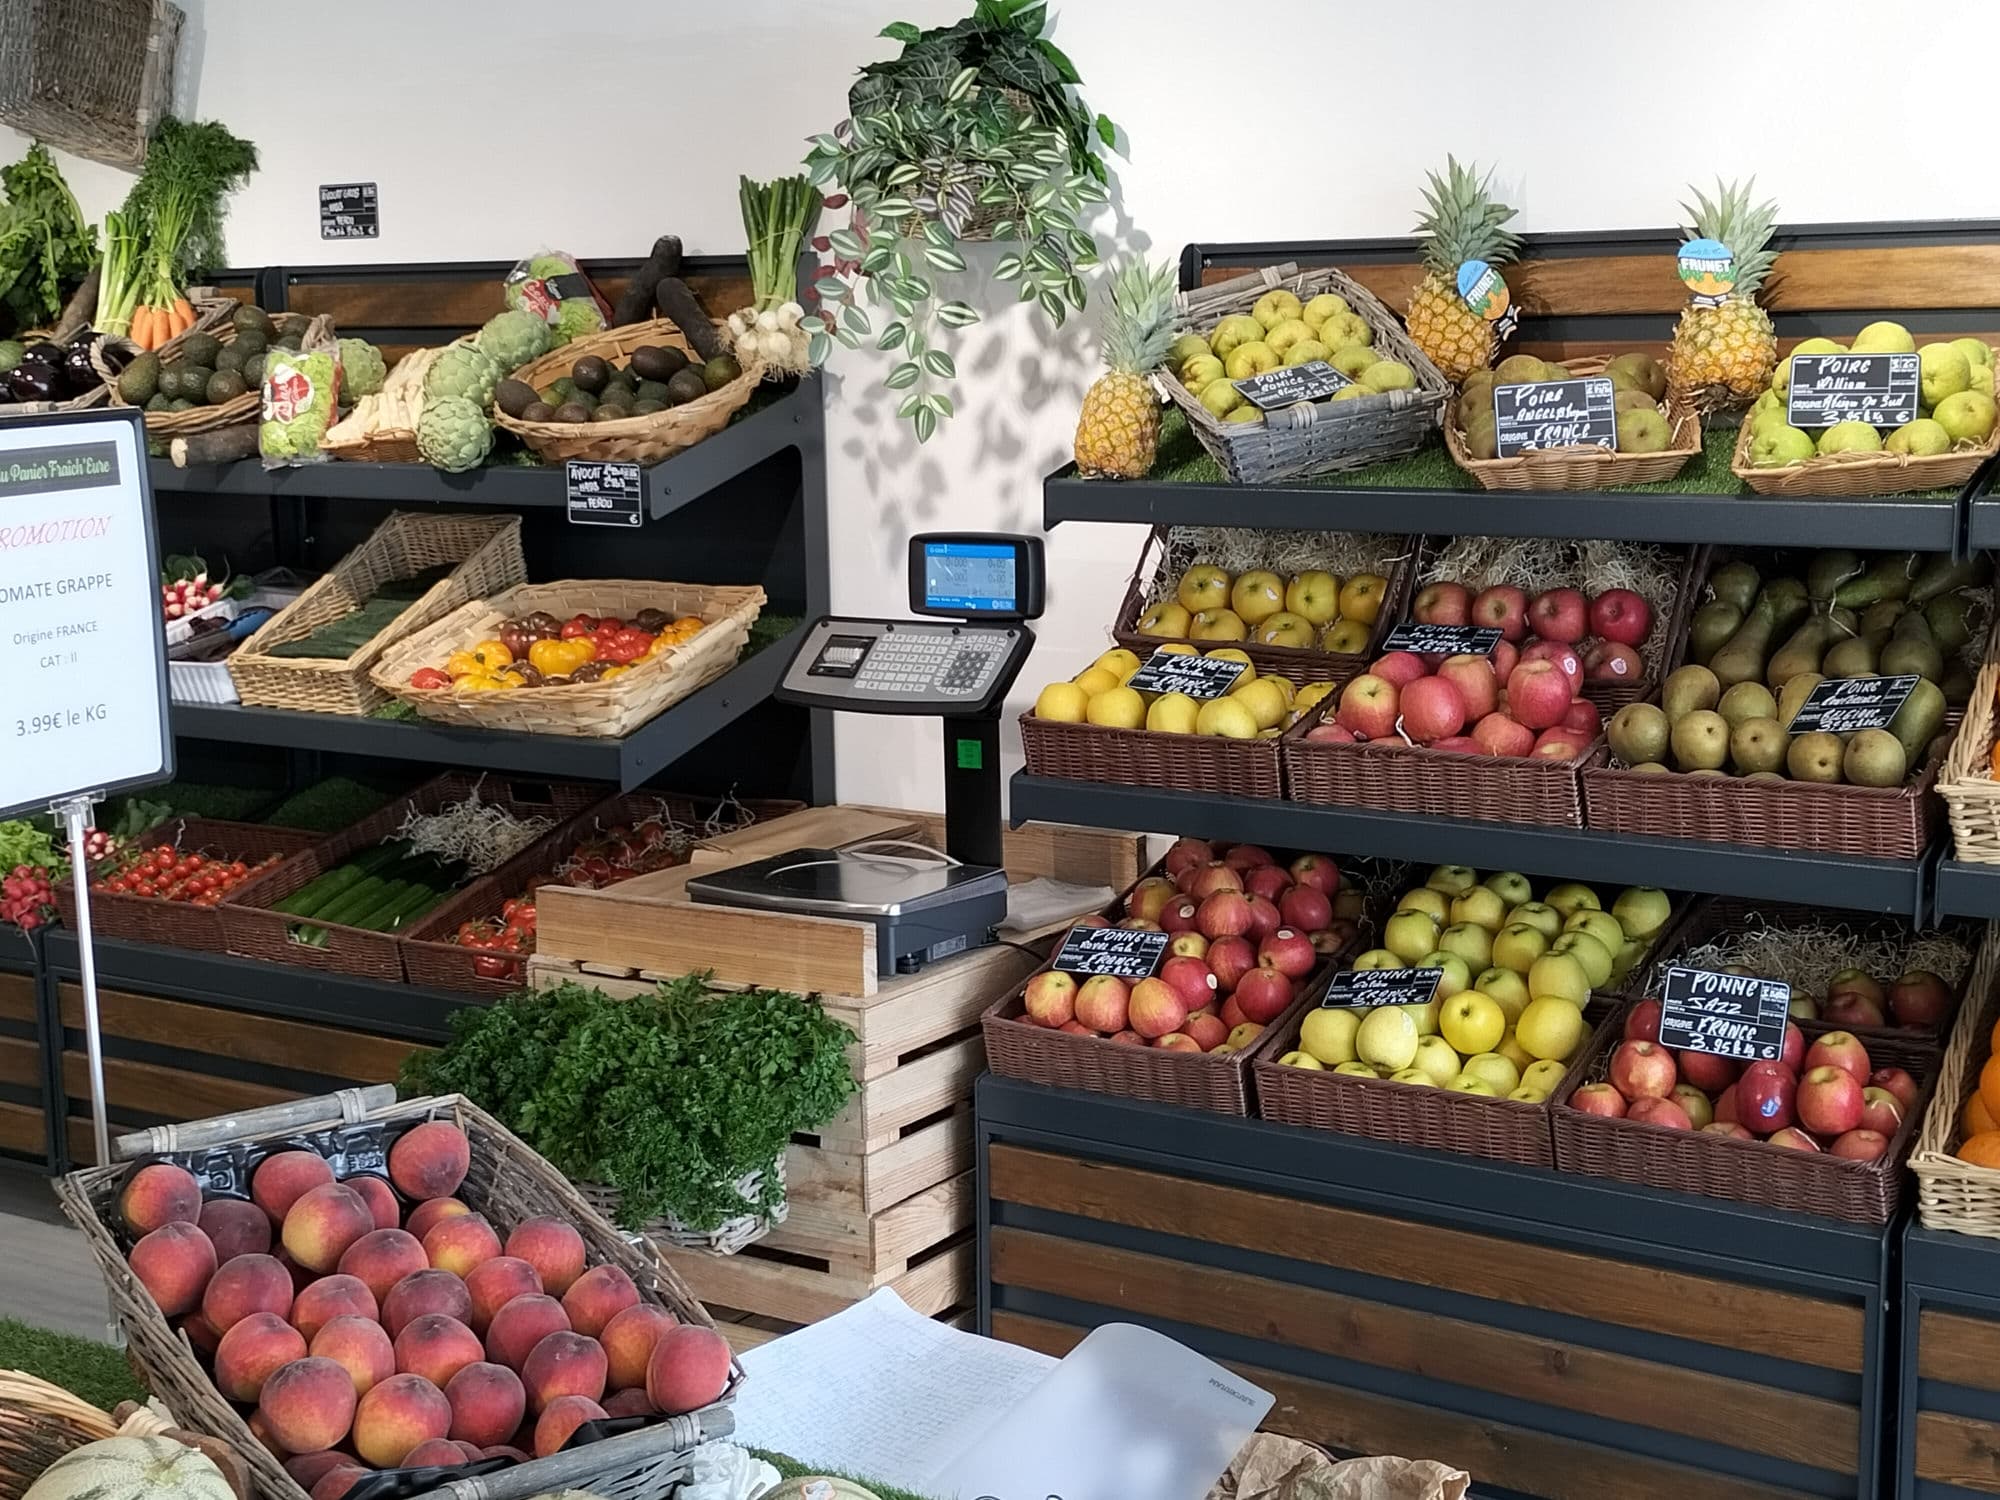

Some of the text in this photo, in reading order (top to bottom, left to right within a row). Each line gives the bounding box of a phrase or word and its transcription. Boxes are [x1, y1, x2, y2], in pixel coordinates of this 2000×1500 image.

[1679, 257, 1732, 273] FRUNET
[1466, 267, 1497, 307] FRUNET
[1253, 369, 1294, 387] POIRE
[1818, 356, 1872, 375] POIRE
[1534, 423, 1591, 442] FRANCE
[0, 471, 9, 483] u
[10, 463, 48, 482] Panier
[0, 515, 113, 550] ROMOTION
[0, 572, 113, 603] OMATE GRAPPE
[13, 620, 98, 645] Origine FRANCE
[40, 653, 62, 668] CAT
[16, 703, 107, 736] 3.99€ le KG
[1691, 972, 1759, 997] POMME
[1687, 997, 1742, 1014] JAZZ
[1697, 1016, 1757, 1041] FRANCE
[1688, 1032, 1732, 1055] 3.95
[1761, 1046, 1776, 1059] €
